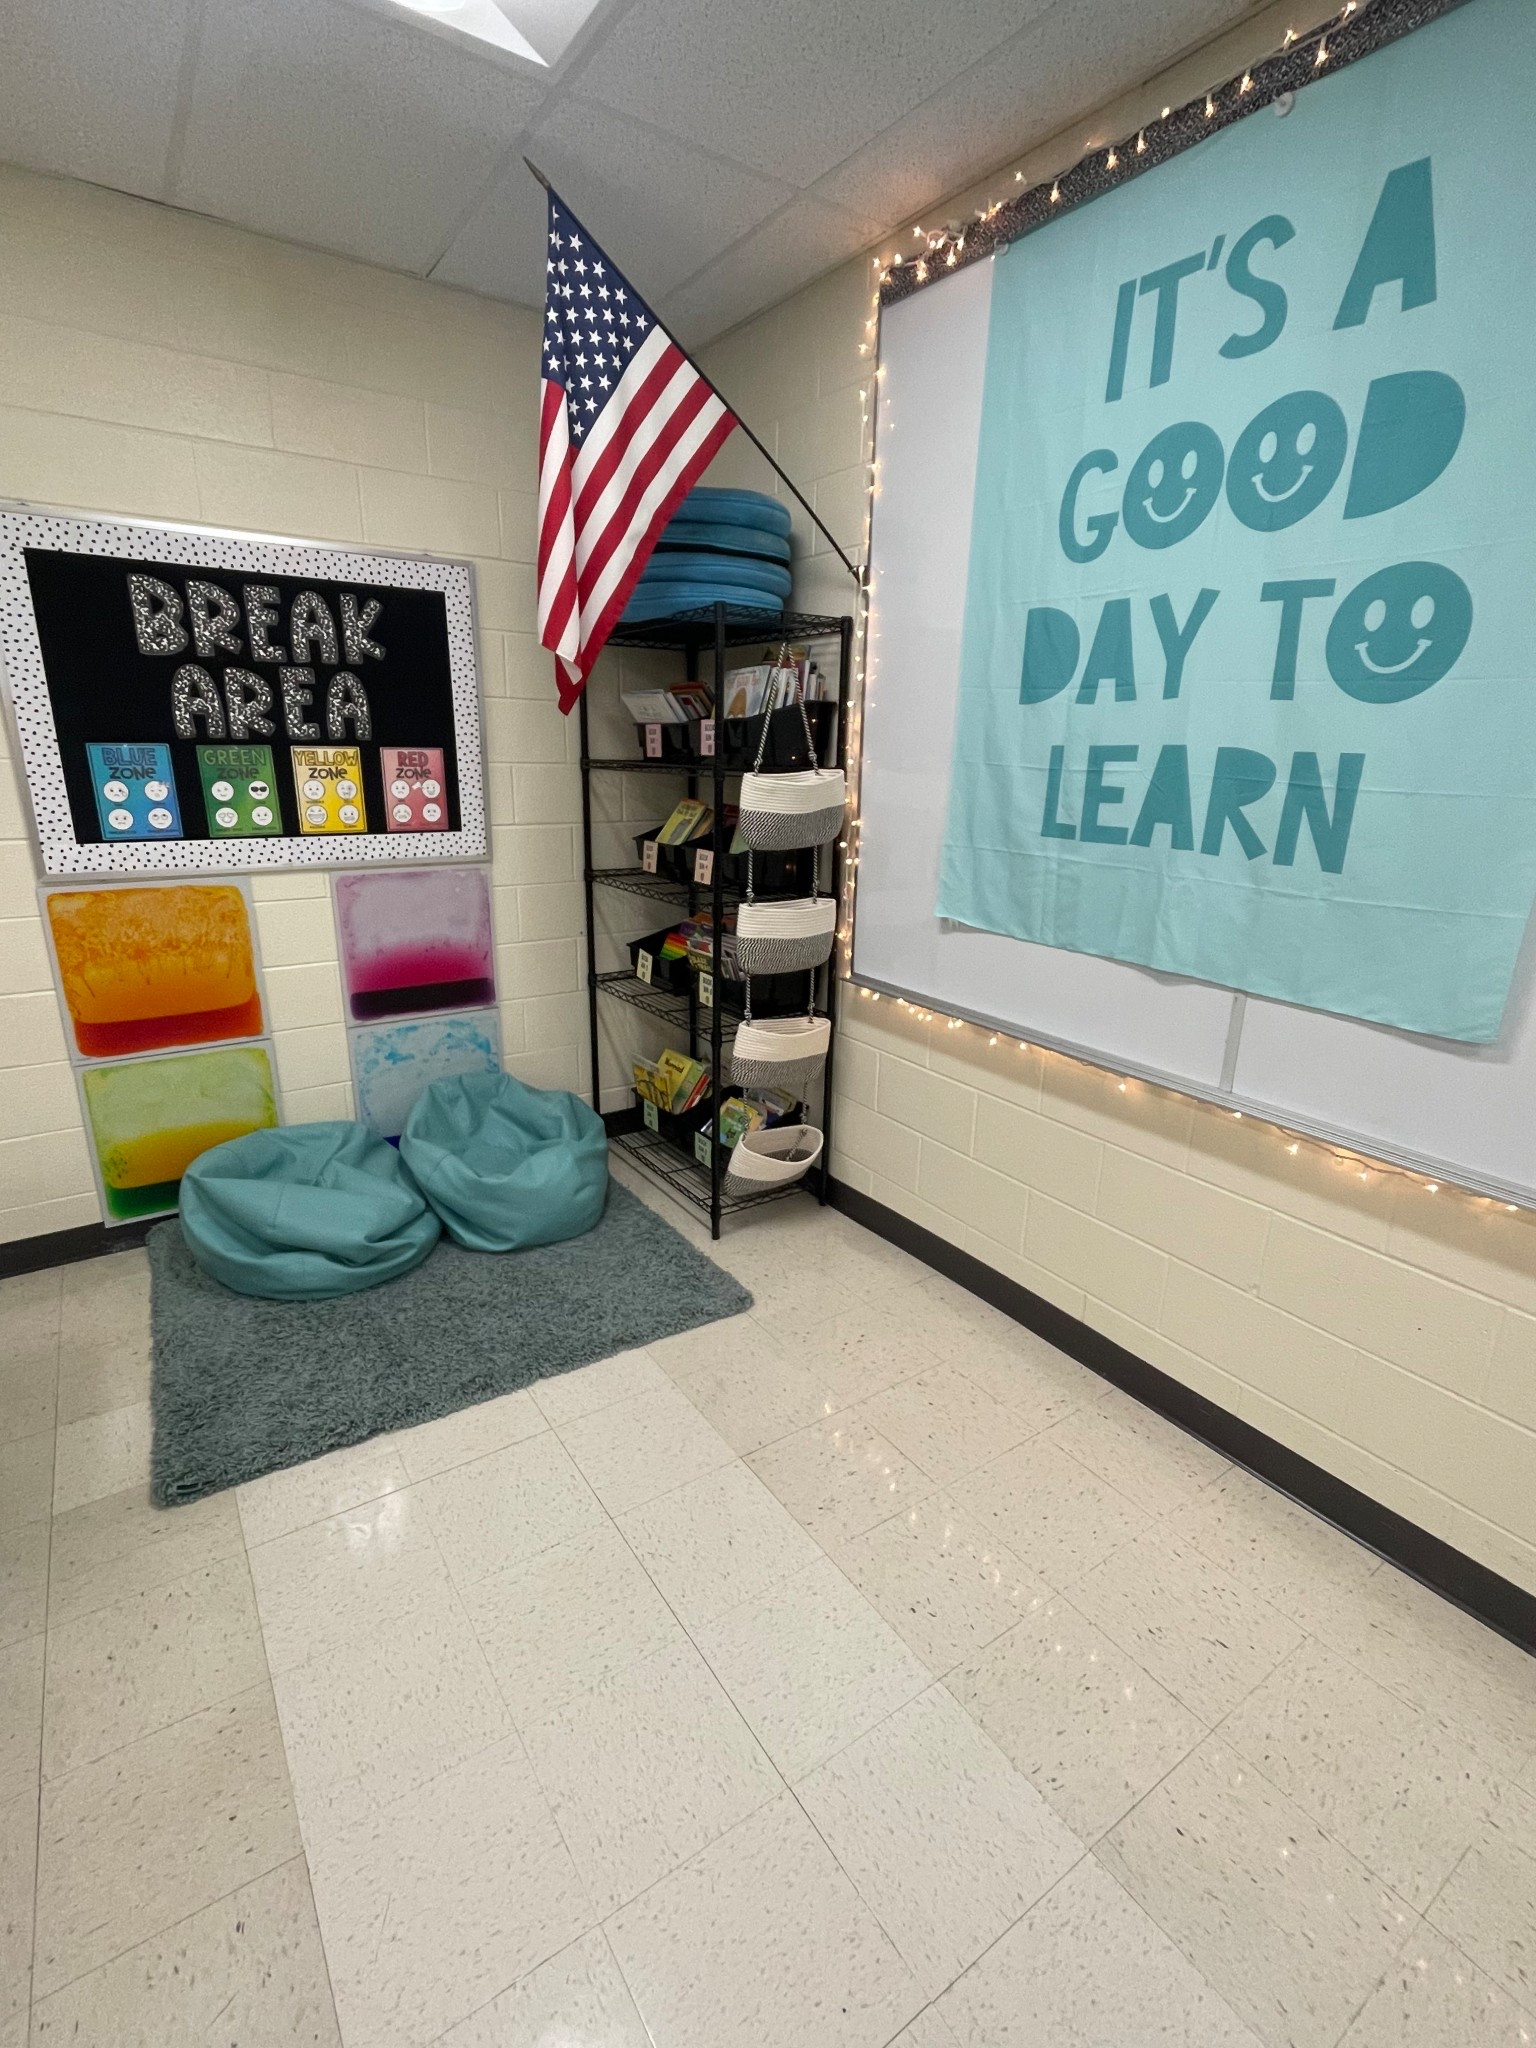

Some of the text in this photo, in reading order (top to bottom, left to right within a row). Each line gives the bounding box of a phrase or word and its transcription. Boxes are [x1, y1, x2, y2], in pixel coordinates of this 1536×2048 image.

[1105, 156, 1437, 404] IT'S A
[1058, 370, 1466, 564] GOOD
[127, 573, 386, 664] BREAK
[1018, 561, 1473, 706] DAY TO
[171, 663, 372, 741] AREA
[102, 747, 157, 766] BLUE
[203, 749, 266, 766] GREEN
[294, 750, 358, 766] YELLOW
[397, 751, 429, 767] RED
[1040, 744, 1366, 875] LEARN
